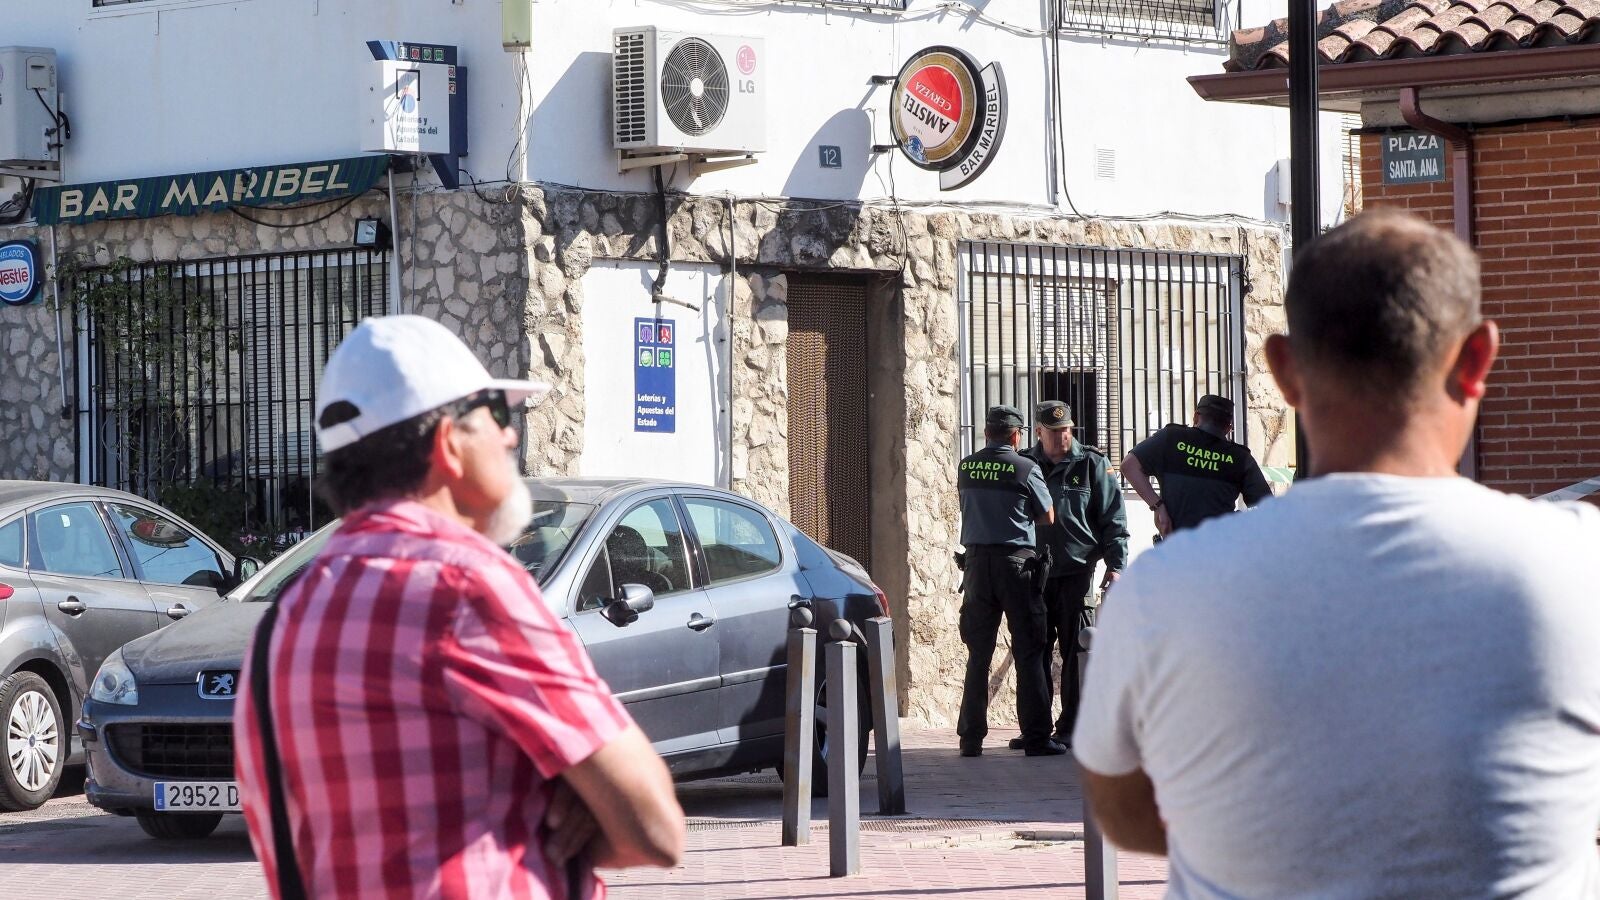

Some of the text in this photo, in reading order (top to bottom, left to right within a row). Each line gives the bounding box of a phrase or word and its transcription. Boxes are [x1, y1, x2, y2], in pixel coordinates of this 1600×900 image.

[738, 79, 755, 94] LG
[915, 81, 952, 111] CERVEZA
[903, 93, 950, 134] AMSTEL
[427, 127, 438, 135] del
[960, 83, 998, 176] BAR MARIBEL
[1389, 135, 1439, 152] PLAZA
[824, 149, 837, 165] 12
[1389, 158, 1439, 179] SANTA ANA
[59, 164, 349, 218] BAR MARIBEL
[637, 394, 660, 402] Loterías
[637, 406, 674, 415] Apuestas del
[637, 418, 657, 426] Estado
[1176, 441, 1234, 464] GUARDIA
[961, 461, 1016, 473] GUARDIA
[1186, 456, 1219, 471] CIVIL
[969, 470, 1000, 481] CIVIL
[169, 785, 220, 807] 2952
